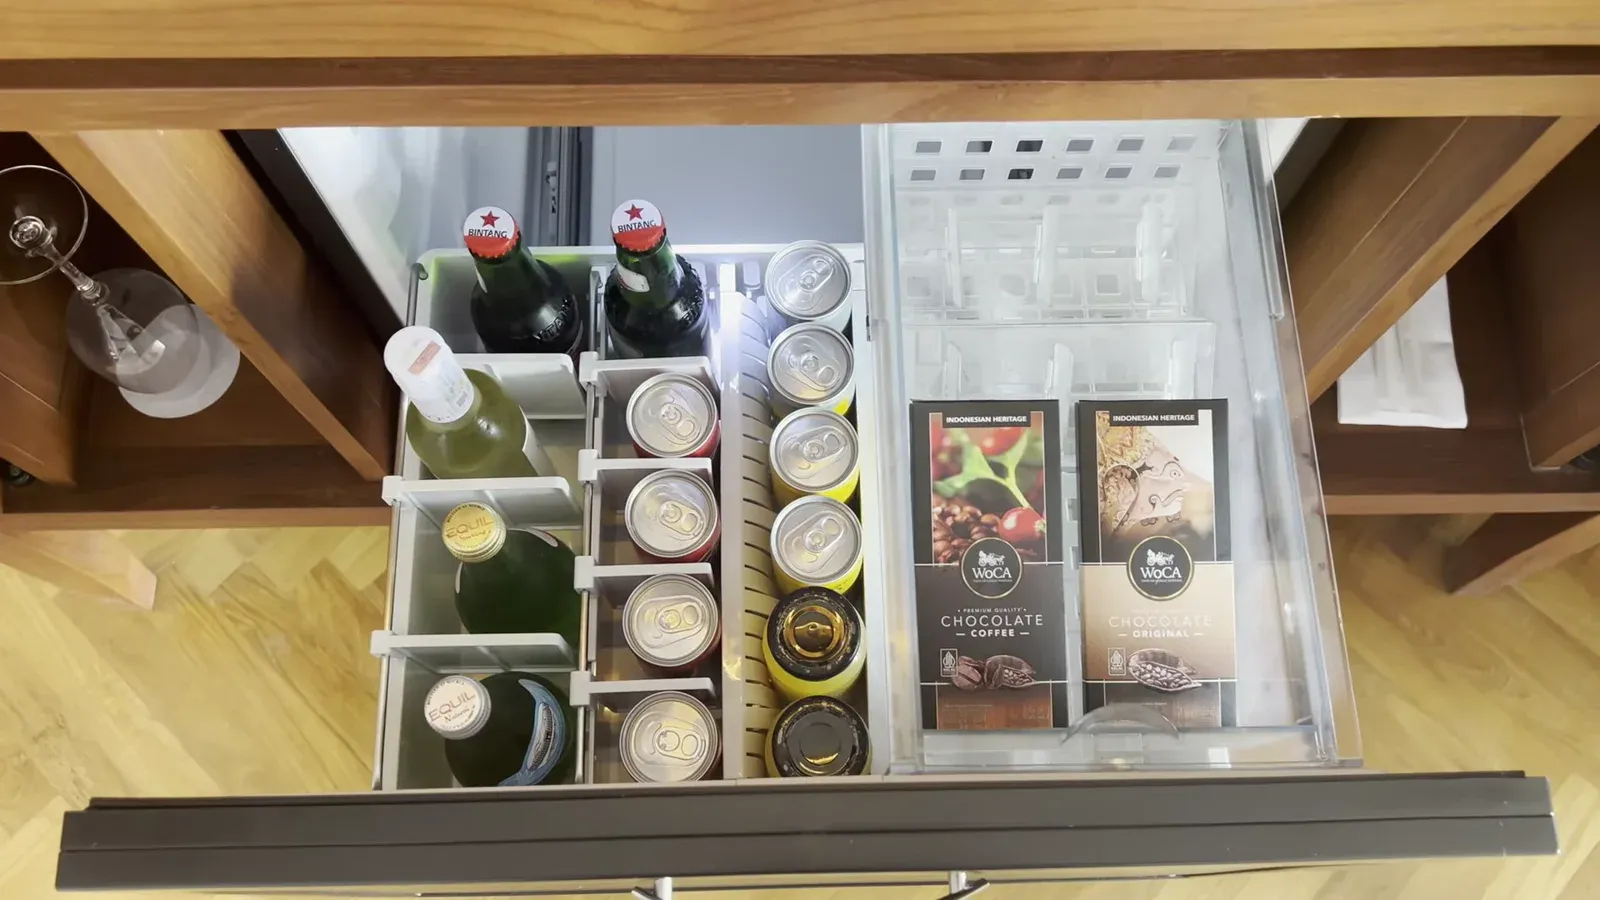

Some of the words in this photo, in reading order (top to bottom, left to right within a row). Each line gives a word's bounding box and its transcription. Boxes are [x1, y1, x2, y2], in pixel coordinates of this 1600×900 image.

[617, 219, 657, 233] BINTANG
[468, 228, 508, 239] BINTANG
[945, 416, 992, 424] INDONESIAN
[993, 415, 1027, 423] HERITAGE
[445, 516, 494, 539] EQUIL
[972, 567, 1012, 579] WoCA
[1140, 566, 1182, 579] WoCA
[940, 614, 1044, 627] CHOCOLATE
[1108, 614, 1213, 628] CHOCOLATE
[970, 629, 1015, 637] COFFEE
[1132, 629, 1190, 638] ORIGINAL
[428, 692, 476, 722] EQUIL
